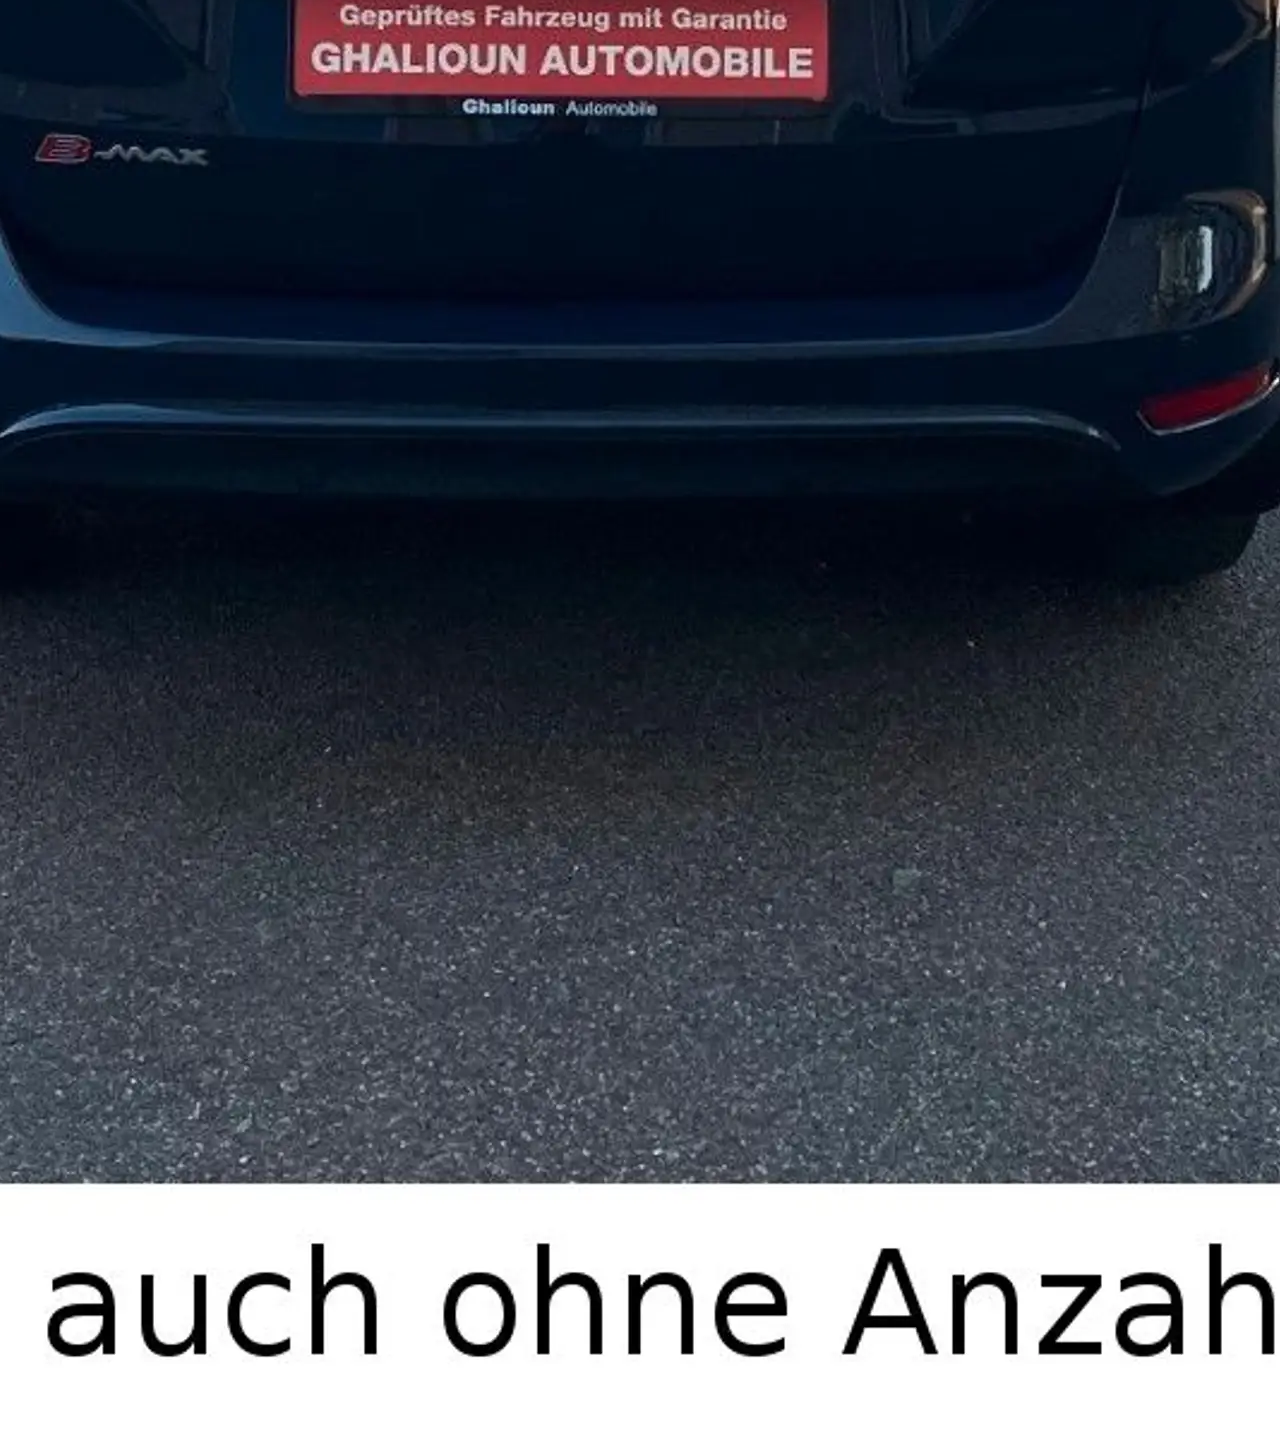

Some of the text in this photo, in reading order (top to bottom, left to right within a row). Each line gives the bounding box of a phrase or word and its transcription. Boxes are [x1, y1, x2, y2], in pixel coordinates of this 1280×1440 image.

[339, 3, 788, 32] Geprüftes Fahrzeug mit Garantie
[311, 42, 814, 79] GHALIOUN AUTOMOBILE
[462, 98, 658, 117] Ghalioun Automobile
